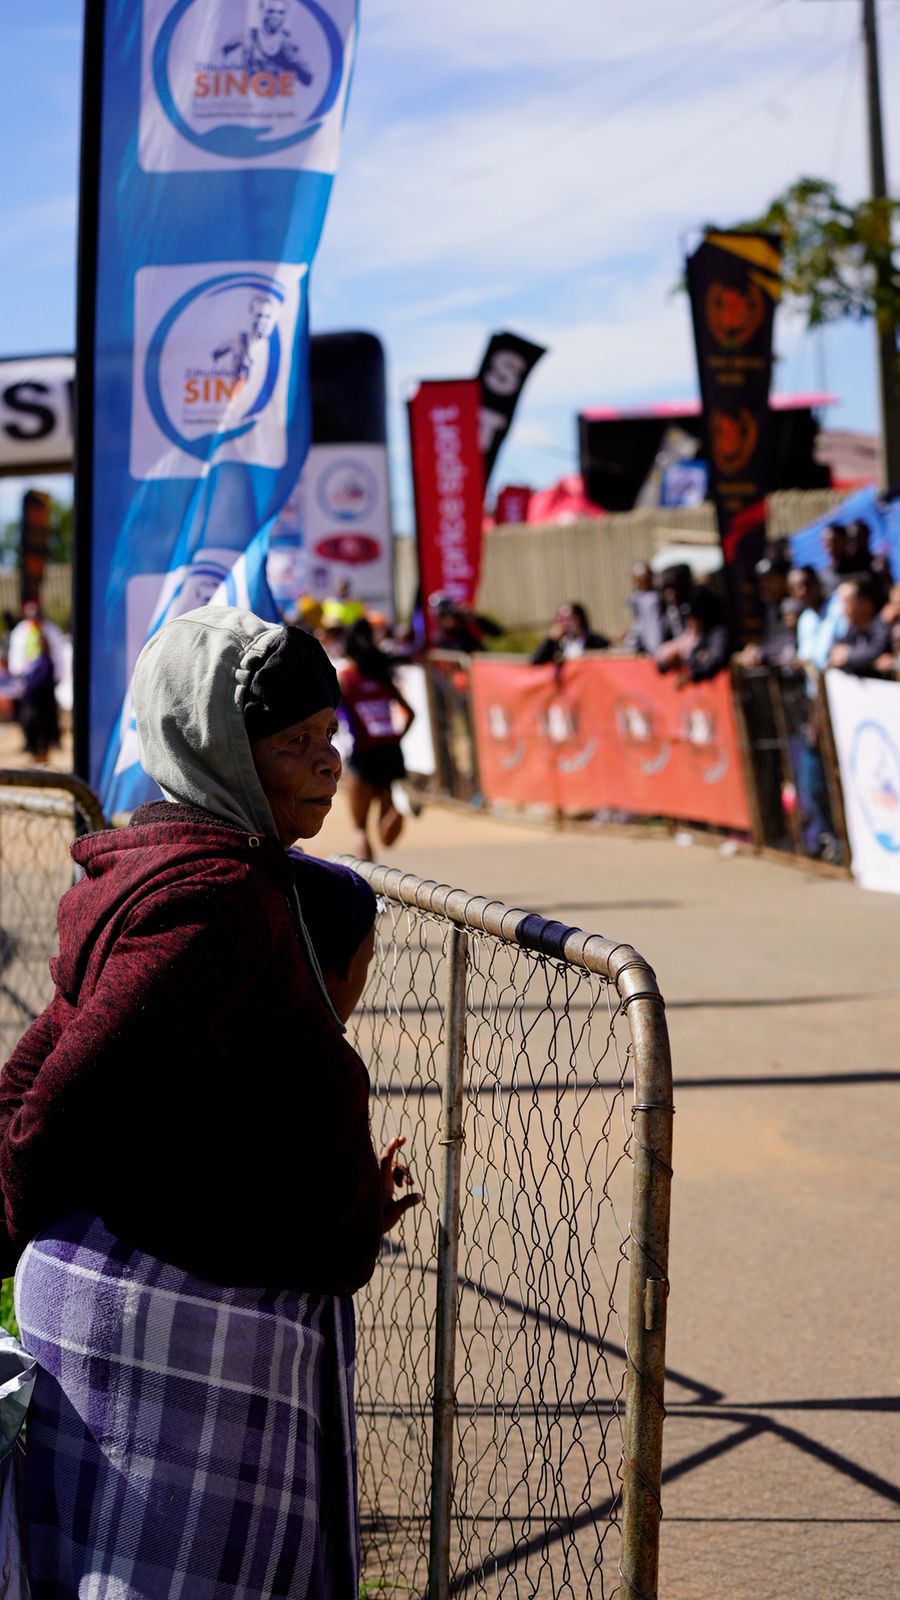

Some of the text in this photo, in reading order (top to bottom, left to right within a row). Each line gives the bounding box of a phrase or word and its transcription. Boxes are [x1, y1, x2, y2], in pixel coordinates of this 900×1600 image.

[193, 71, 296, 100] SINQE
[3, 382, 76, 440] S
[430, 406, 468, 495] sport
[437, 497, 473, 579] price
